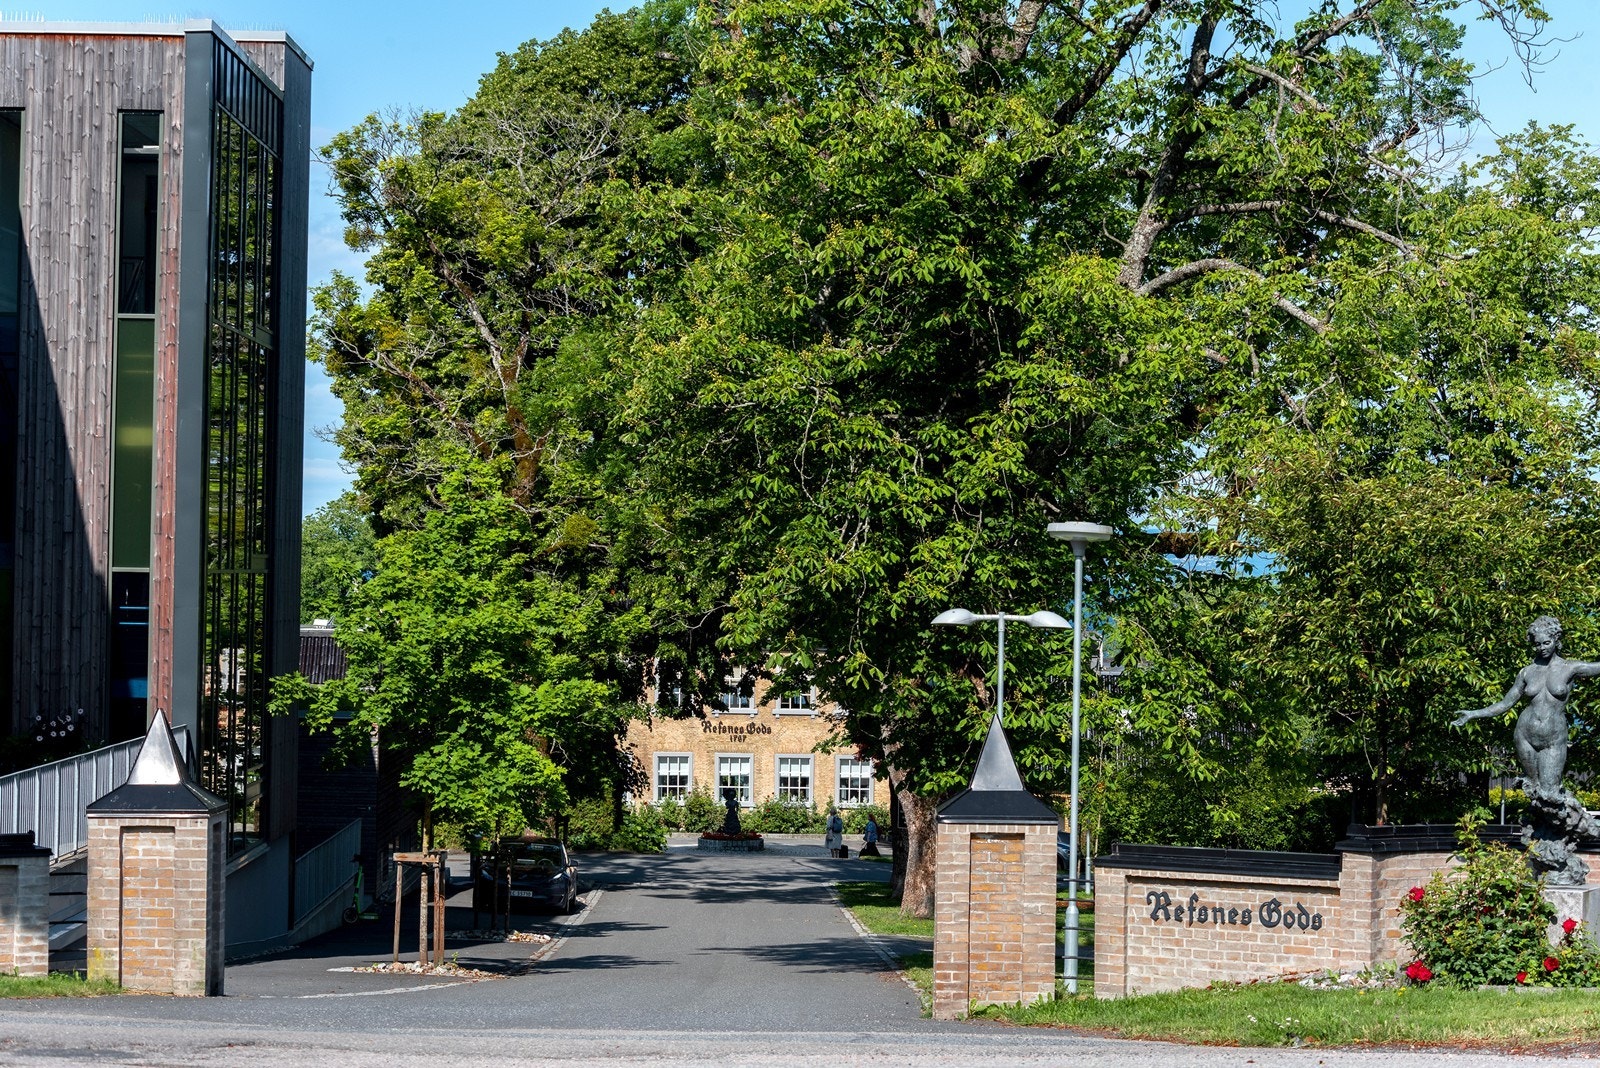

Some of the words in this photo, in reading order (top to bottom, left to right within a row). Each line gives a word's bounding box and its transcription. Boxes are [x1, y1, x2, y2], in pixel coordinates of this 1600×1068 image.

[701, 720, 745, 735] Refsnes
[746, 721, 772, 735] Gods
[1146, 890, 1253, 928] Refsnes
[1258, 897, 1323, 931] Gods
